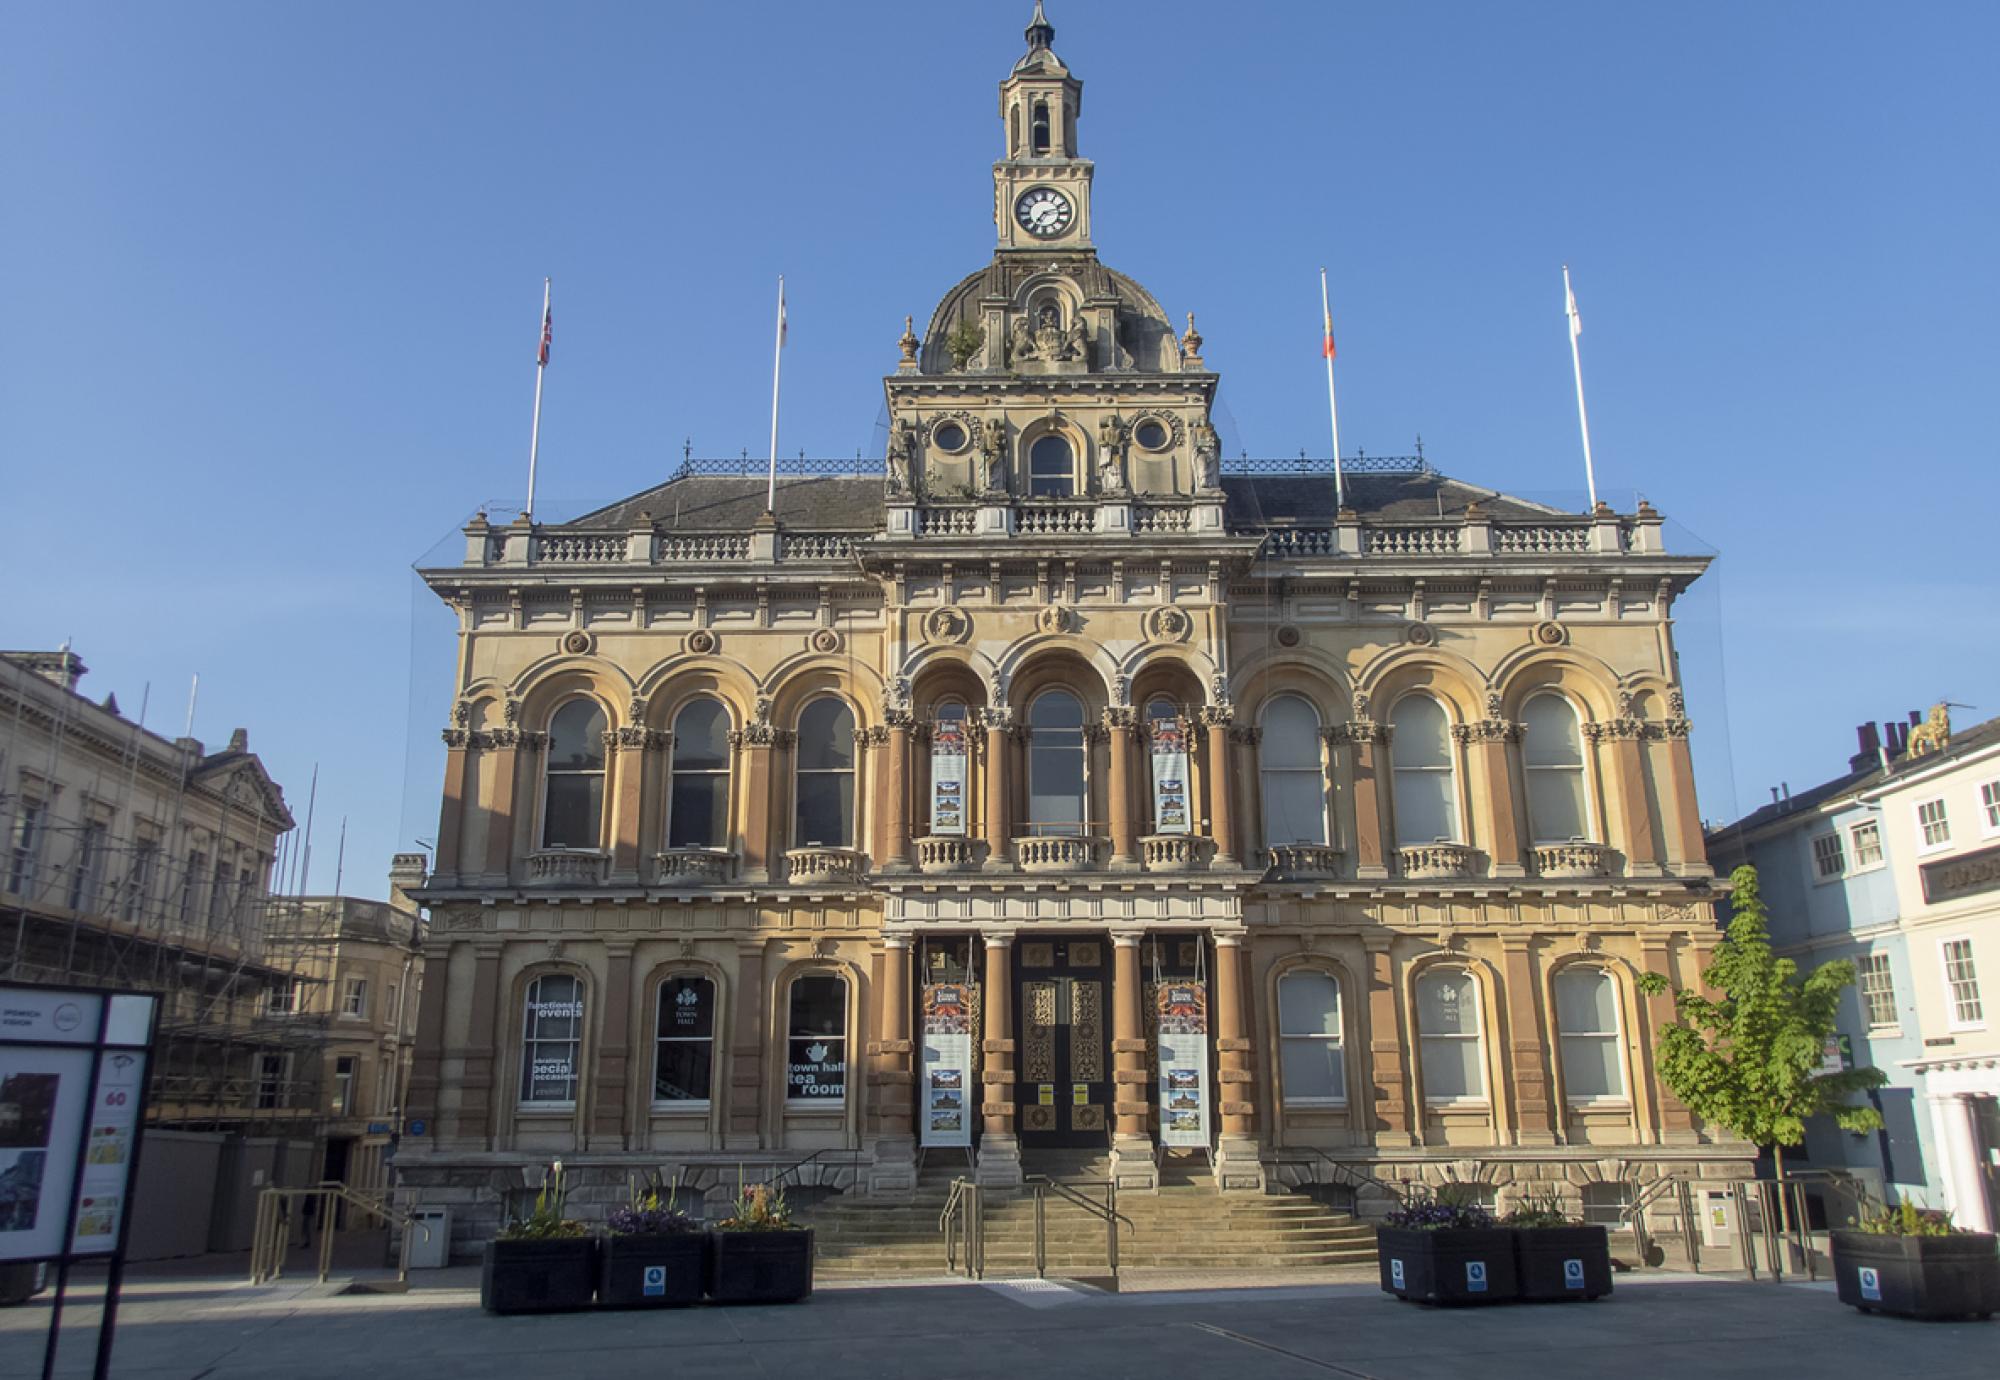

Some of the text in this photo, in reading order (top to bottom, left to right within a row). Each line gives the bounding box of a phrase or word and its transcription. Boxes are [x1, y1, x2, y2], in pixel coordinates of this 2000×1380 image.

[538, 1009, 582, 1018] events
[789, 1061, 845, 1072] town hall
[789, 1072, 816, 1085] tea
[802, 1083, 845, 1095] room
[105, 1091, 127, 1106] 60
